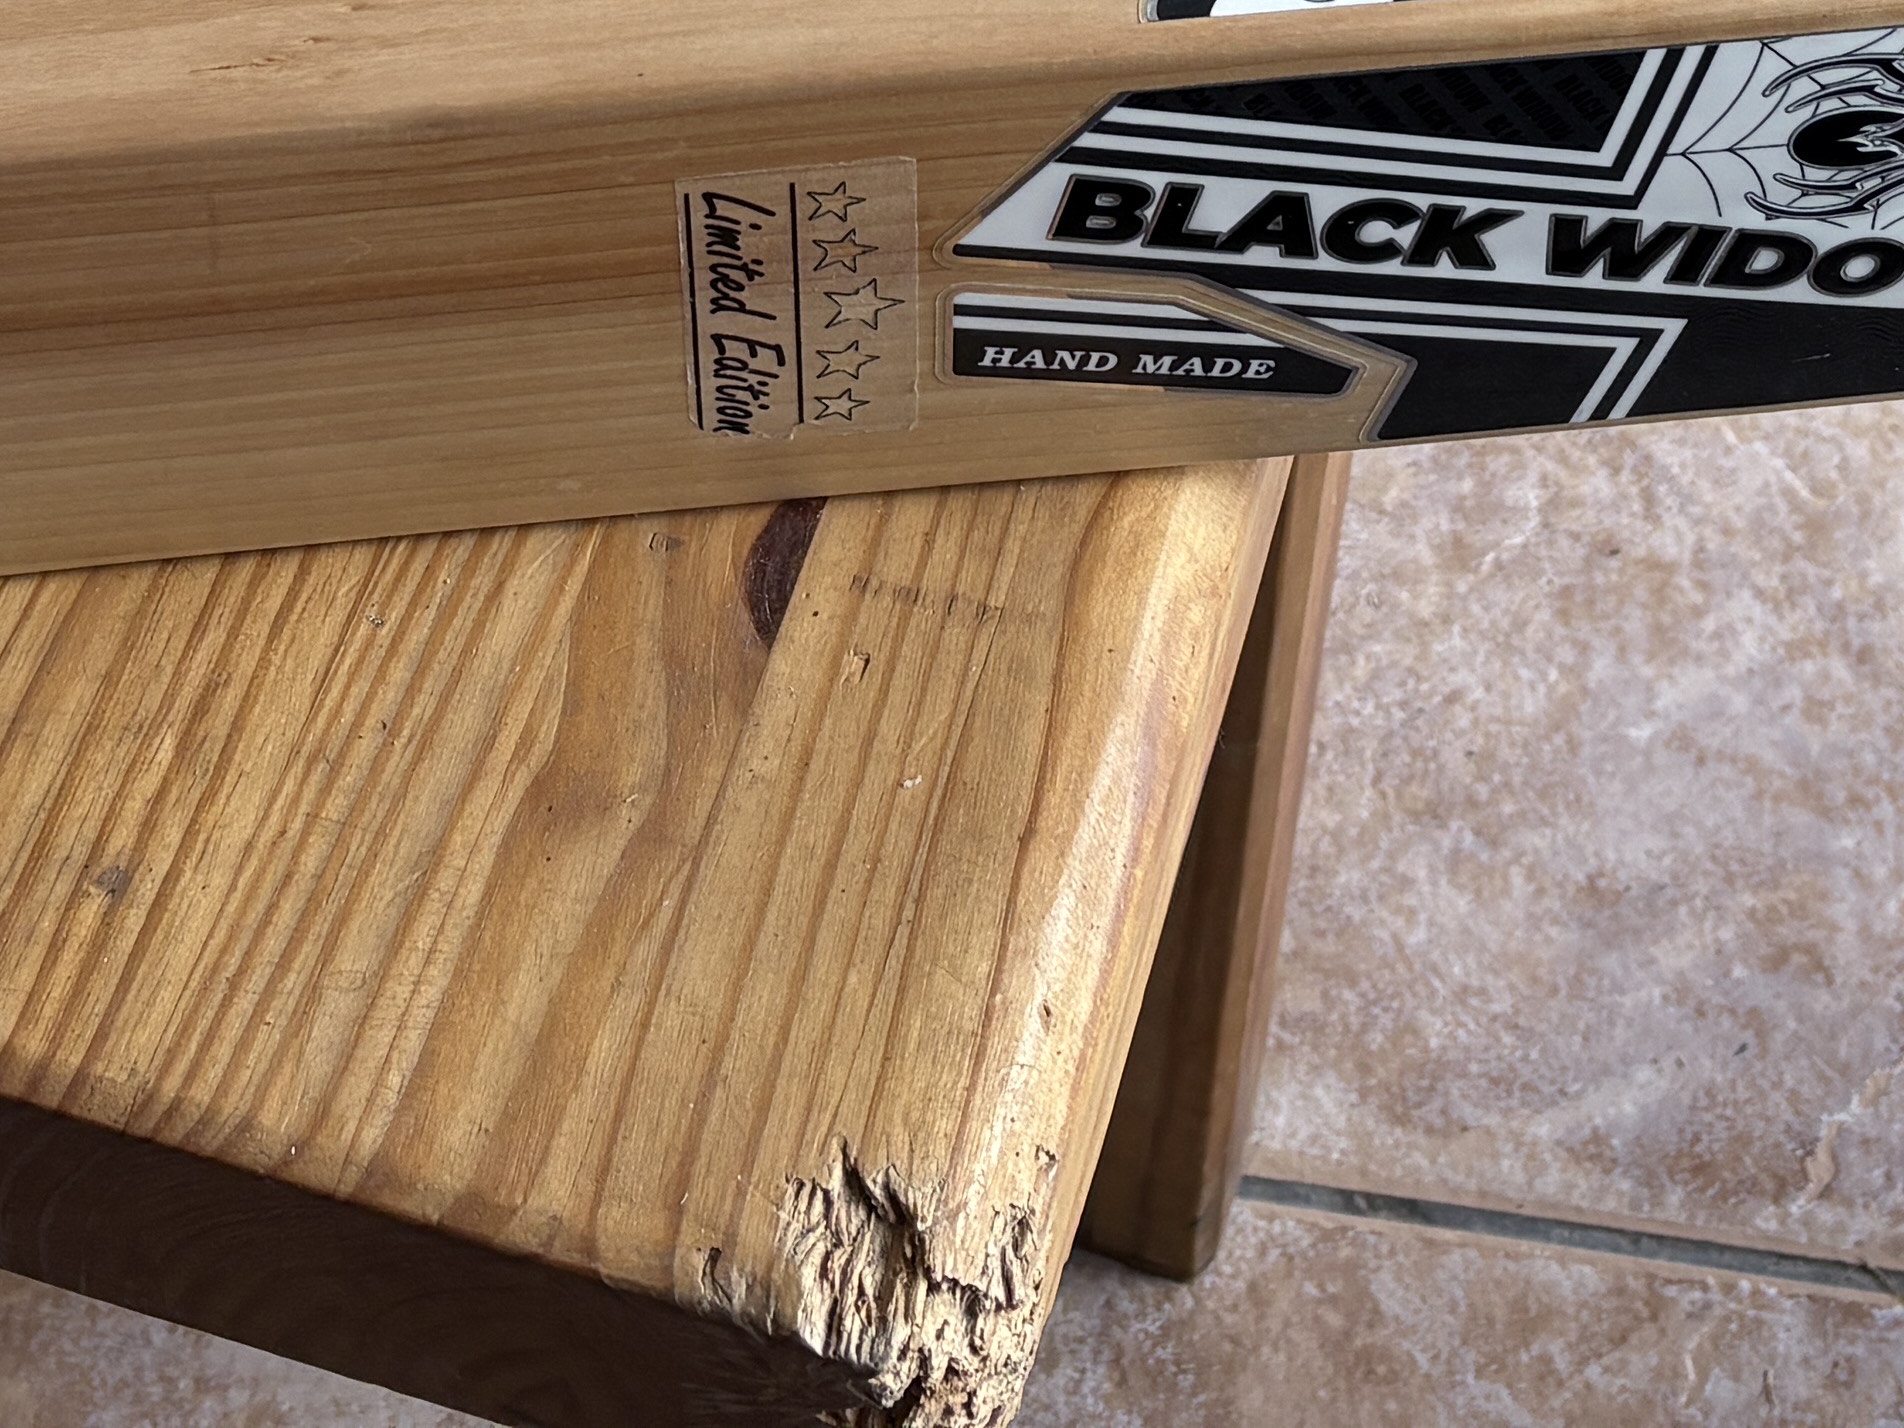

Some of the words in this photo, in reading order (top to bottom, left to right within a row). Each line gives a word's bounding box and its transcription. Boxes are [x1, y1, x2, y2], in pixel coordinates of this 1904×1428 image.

[702, 191, 779, 321] Limited
[1047, 173, 1524, 272] BLACK
[709, 331, 786, 436] Edition
[977, 345, 1119, 374] HAND
[1132, 352, 1277, 381] MADE
